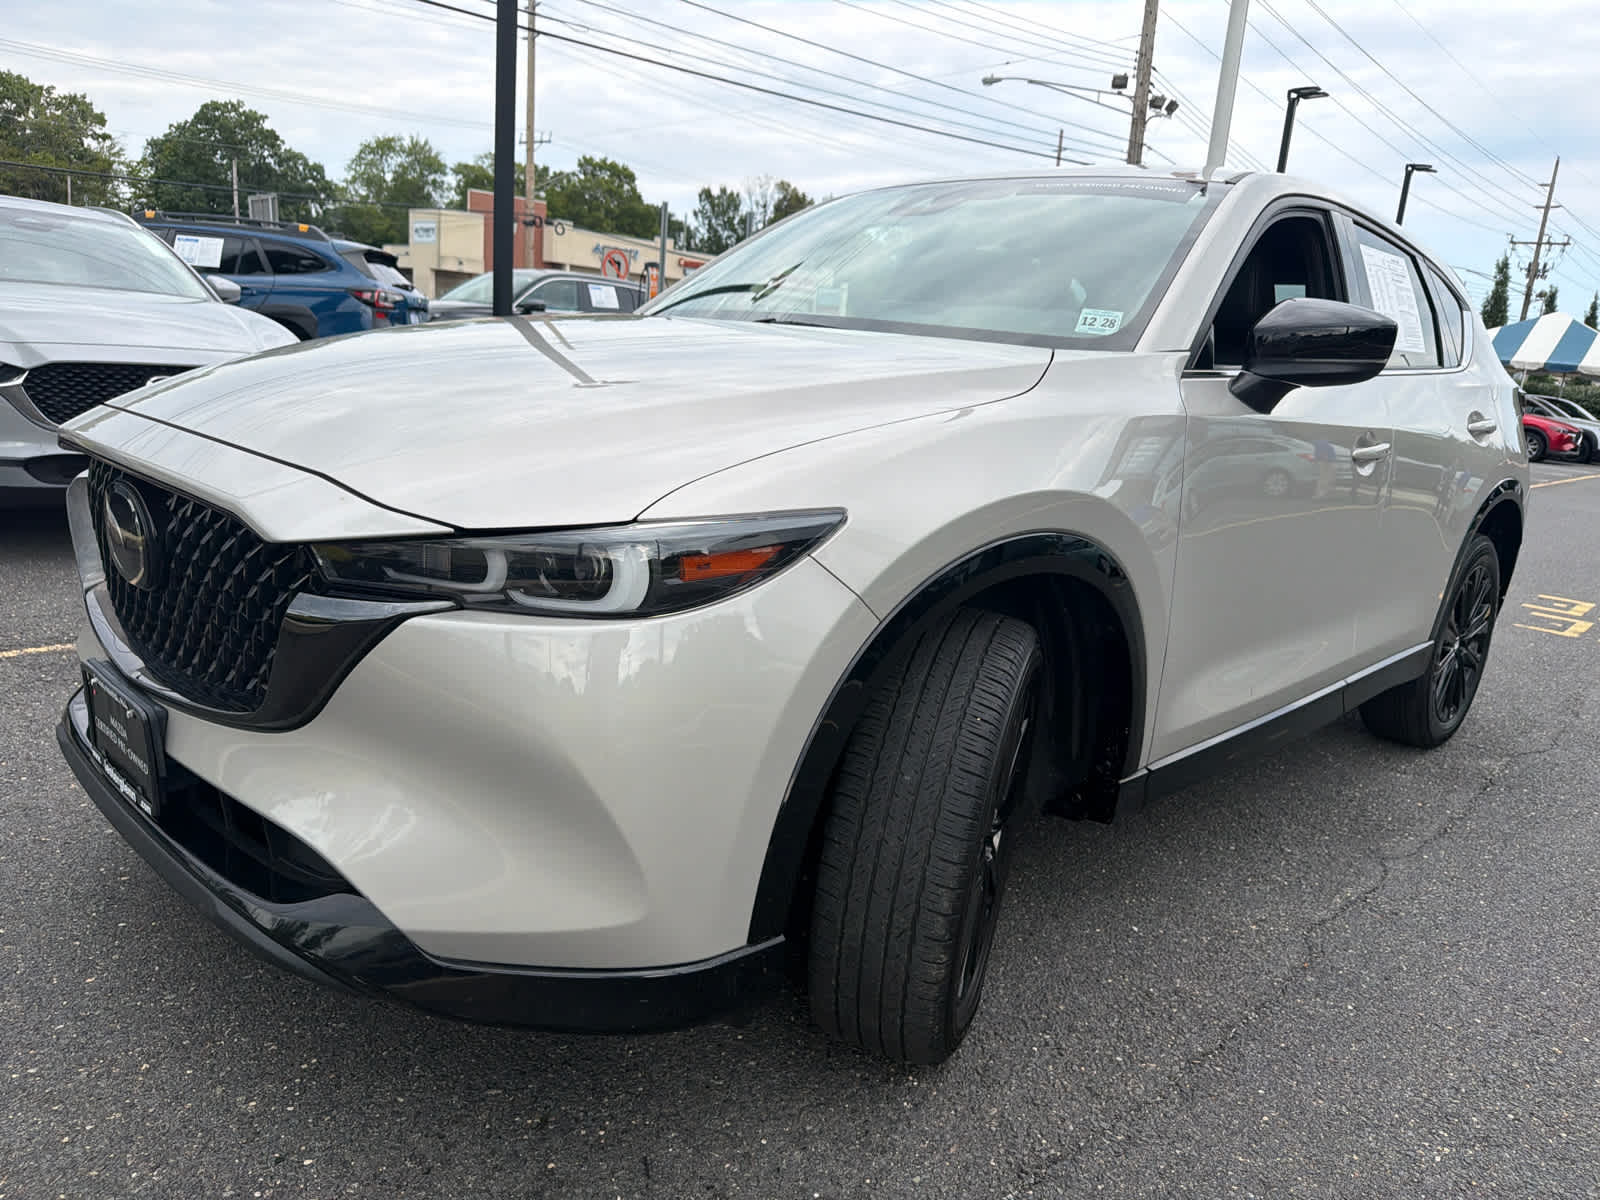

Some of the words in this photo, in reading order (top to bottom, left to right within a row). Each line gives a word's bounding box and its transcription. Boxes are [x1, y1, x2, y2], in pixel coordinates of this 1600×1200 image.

[1081, 316, 1097, 327] 12
[1100, 317, 1117, 329] 28
[111, 715, 128, 741] MAZDA
